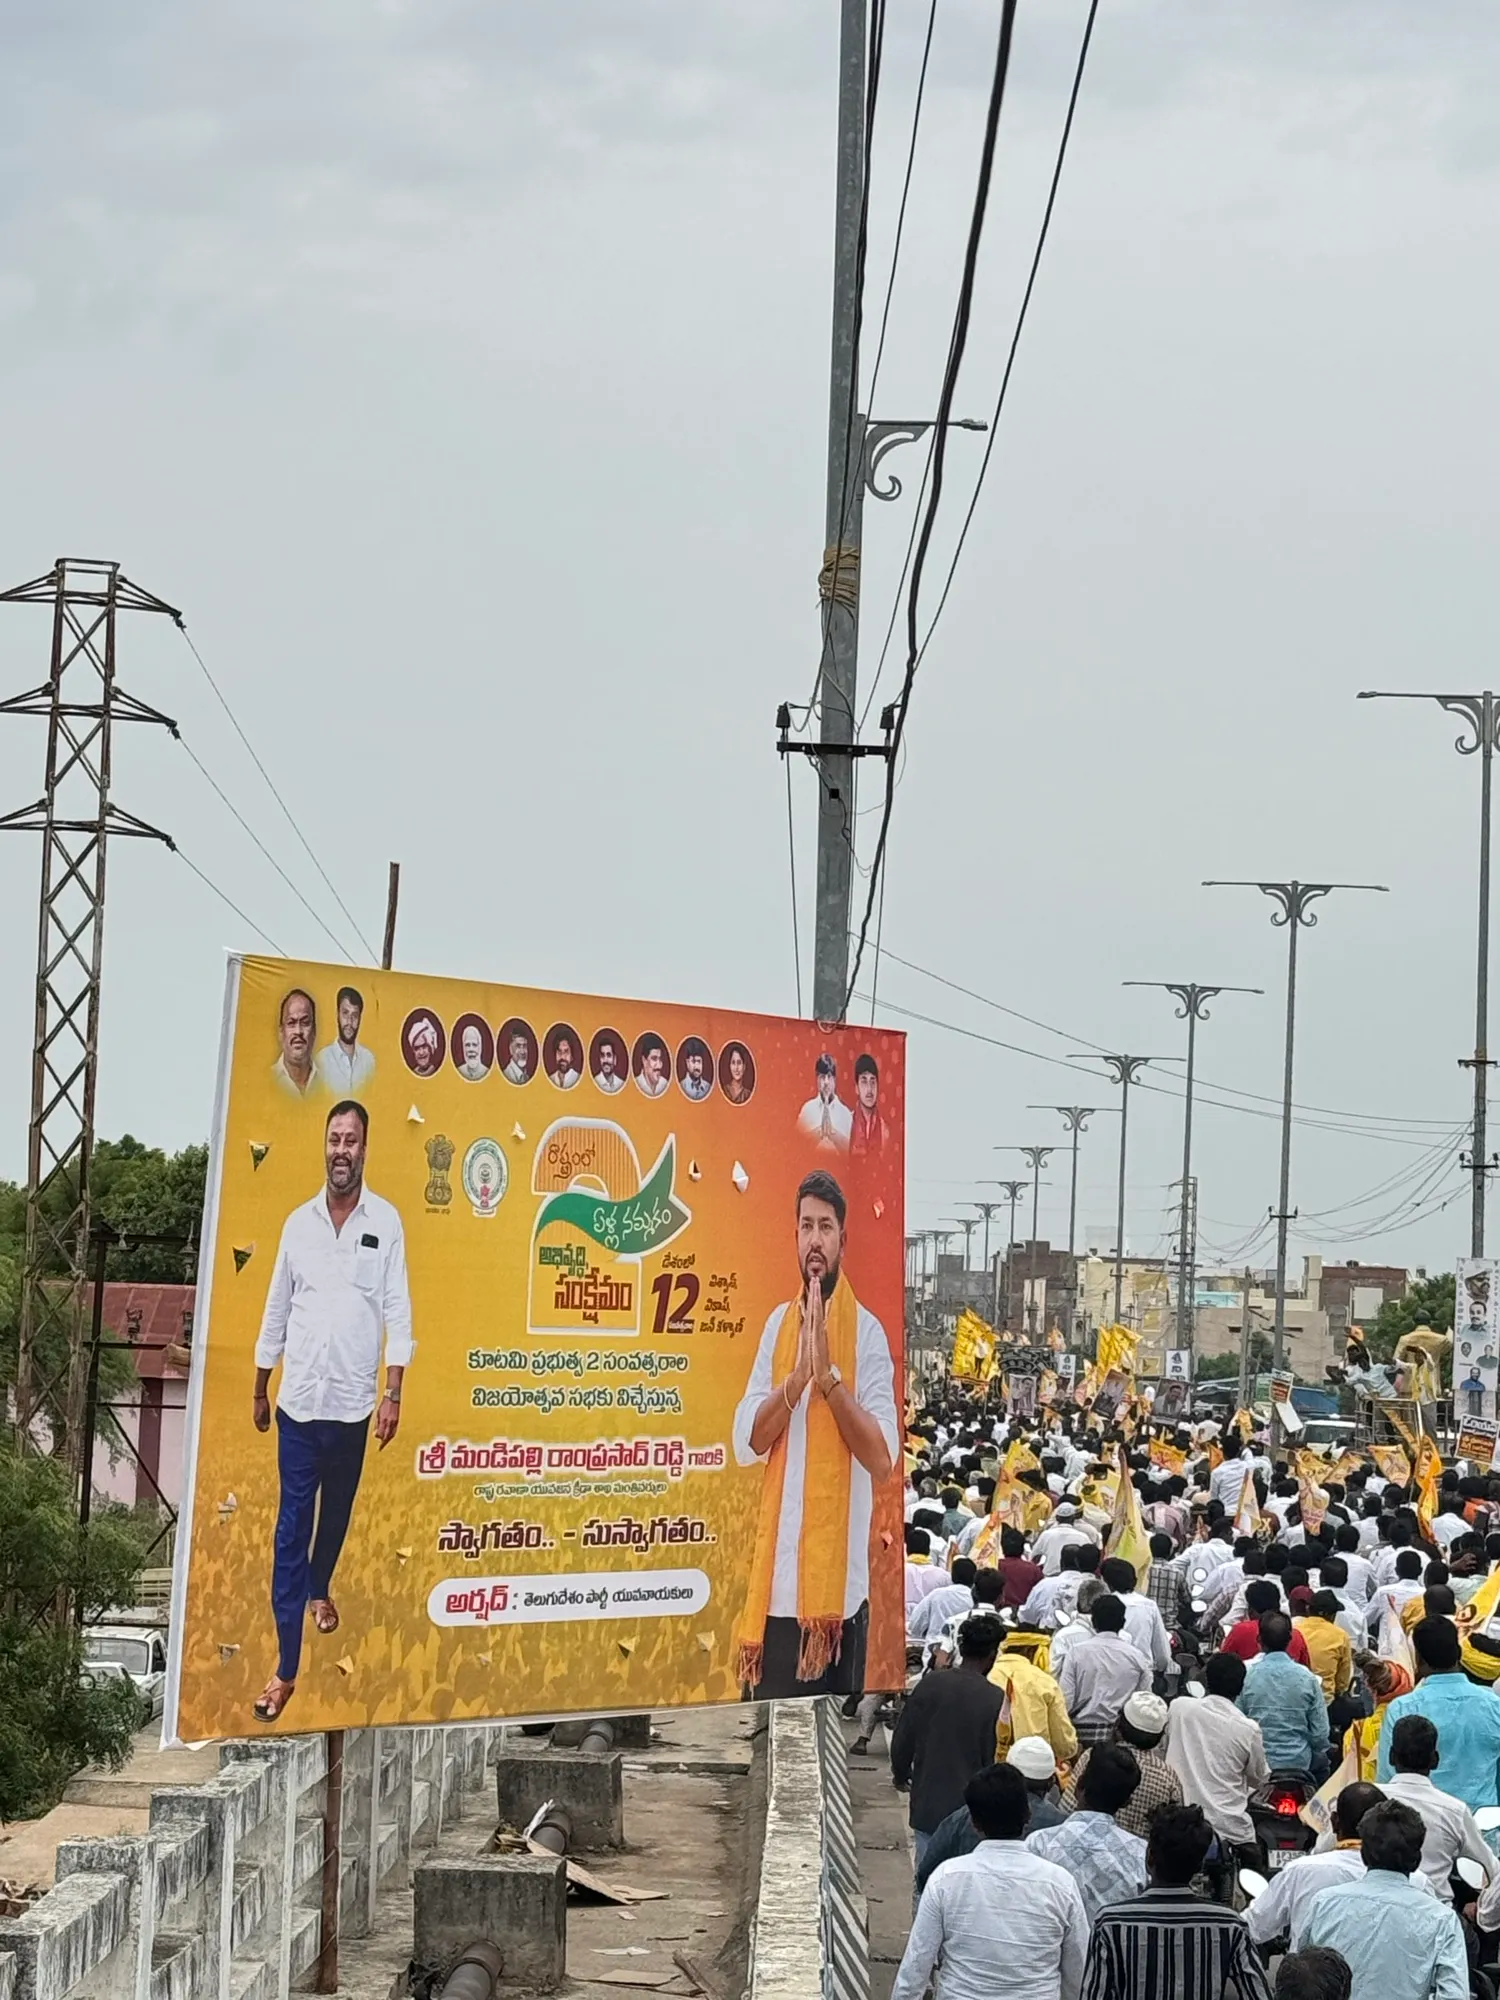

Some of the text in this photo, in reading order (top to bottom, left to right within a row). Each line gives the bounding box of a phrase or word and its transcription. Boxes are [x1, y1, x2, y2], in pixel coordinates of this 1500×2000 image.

[548, 1142, 596, 1180] రాష్ట్రంలో
[593, 1196, 672, 1250] ఏళ్ల నమ్మకం
[554, 1266, 632, 1325] సంక్షేమం
[651, 1273, 701, 1334] 12
[468, 1348, 688, 1378] కూటమి ప్రభుత్వ 2 సంవత్సరాల
[569, 1386, 613, 1410] సభకు
[617, 1383, 682, 1414] విచ్చేస్తున్న
[418, 1440, 724, 1477] శ్రీ మండిపల్లి రాంప్రసాద్ రెడ్డి గారికి
[445, 1585, 509, 1621] అర్షద్
[523, 1587, 584, 1607] తెలుగుదేశం
[585, 1587, 609, 1610] పార్టీ
